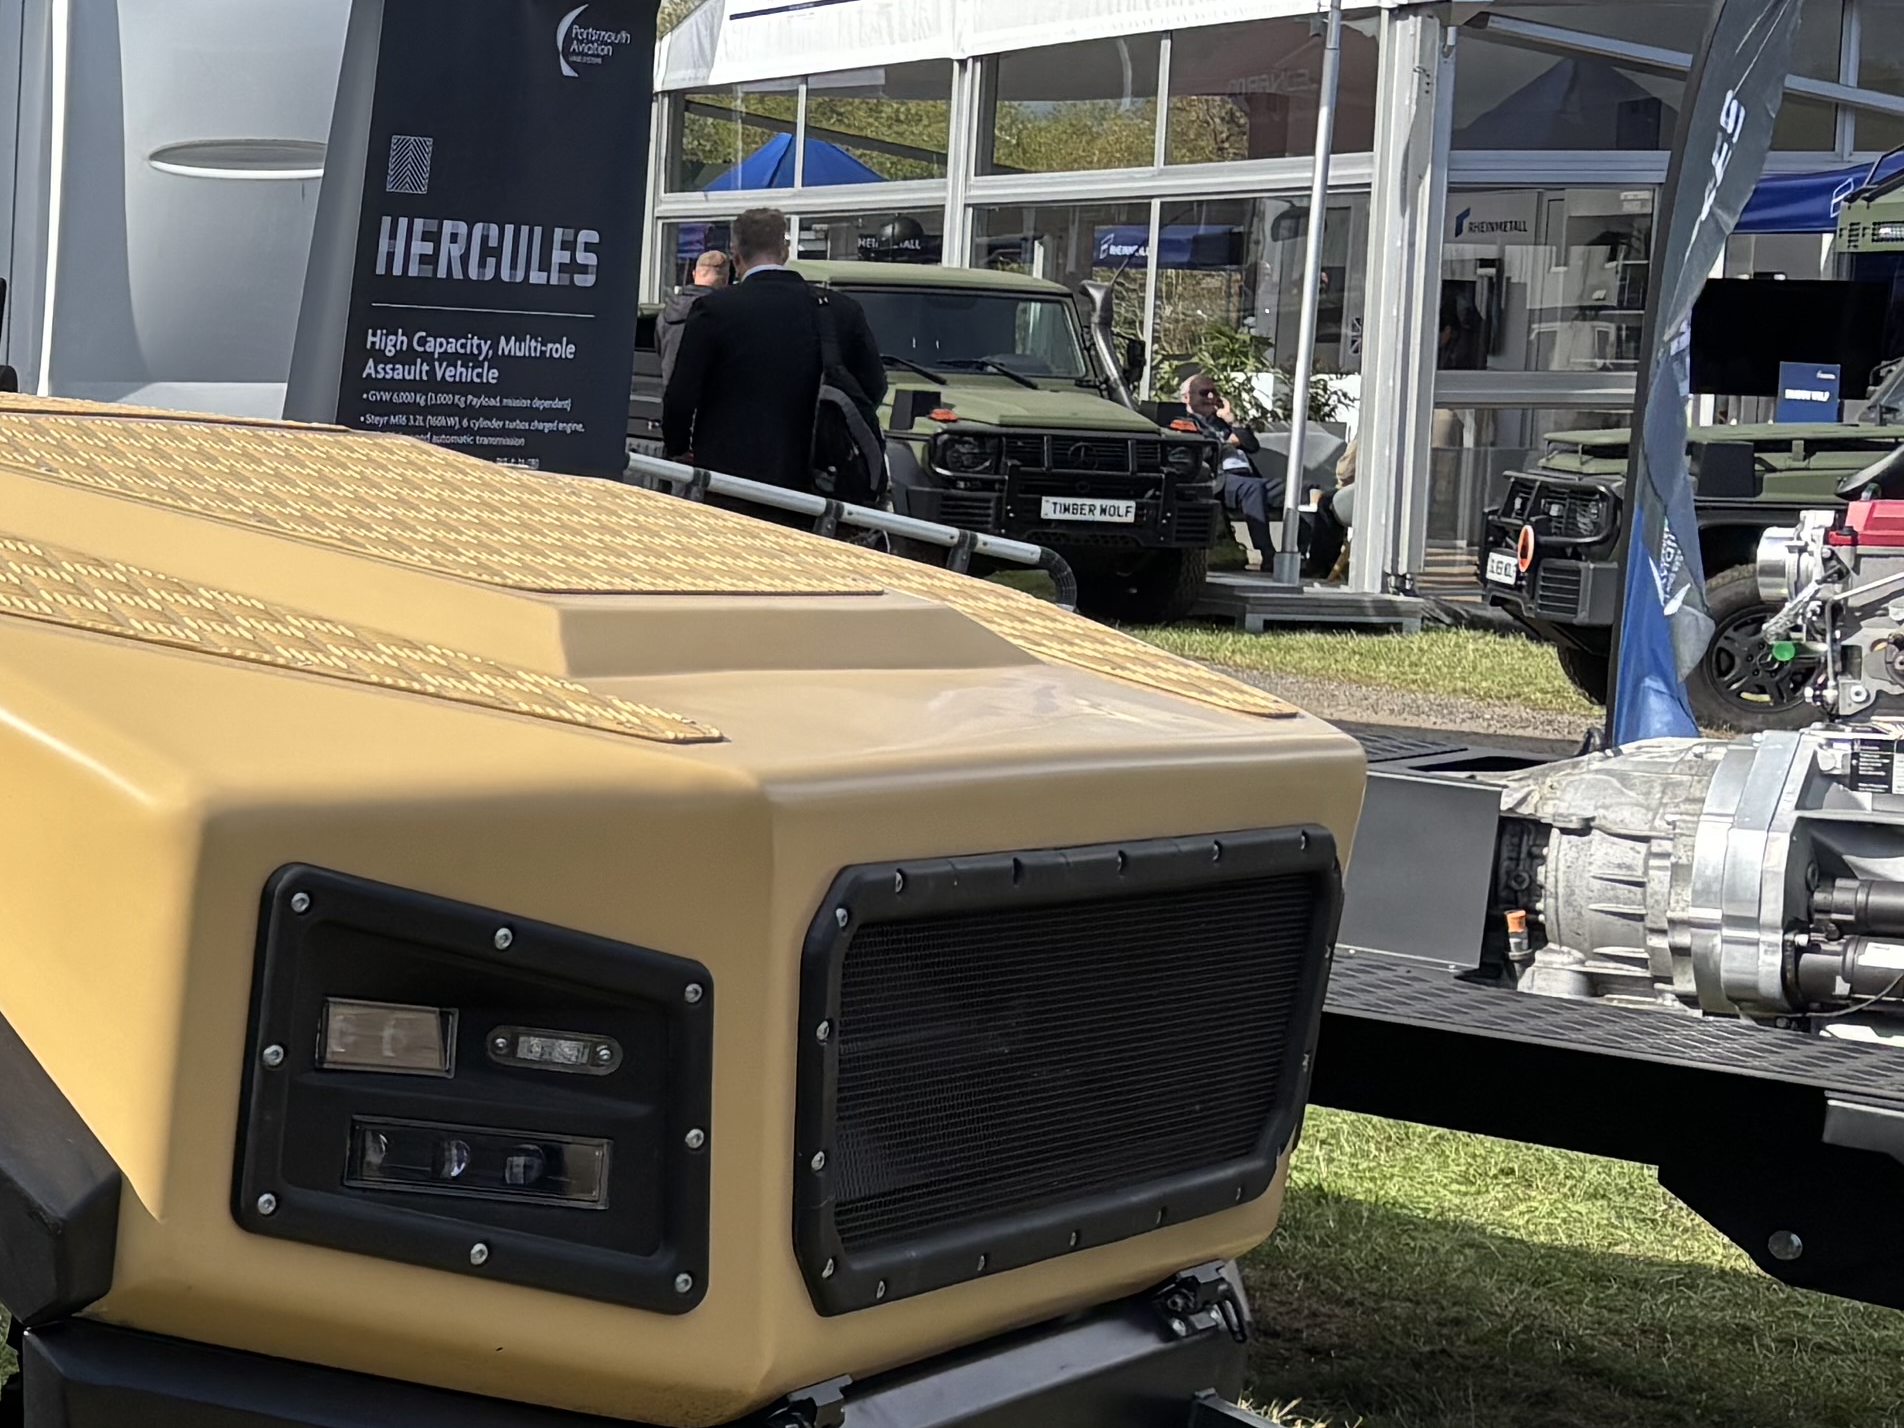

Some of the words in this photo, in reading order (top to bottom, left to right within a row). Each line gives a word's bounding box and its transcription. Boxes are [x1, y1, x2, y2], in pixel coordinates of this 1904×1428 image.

[572, 25, 630, 44] Portsmouth
[570, 40, 612, 56] Aviation
[375, 215, 601, 288] HERCULES
[366, 329, 408, 357] High
[412, 332, 493, 360] Capacity,
[498, 335, 576, 359] Multi-role
[362, 358, 429, 381] Assault
[435, 361, 499, 384] Vehicle
[368, 390, 392, 401] GVW
[365, 413, 388, 428] Steyr
[462, 417, 468, 428] 6
[470, 417, 503, 431] cylinder
[432, 433, 474, 444] automatic
[476, 435, 525, 446] transmission
[1051, 502, 1096, 516] TIMBER
[1099, 504, 1133, 518] WOLF
